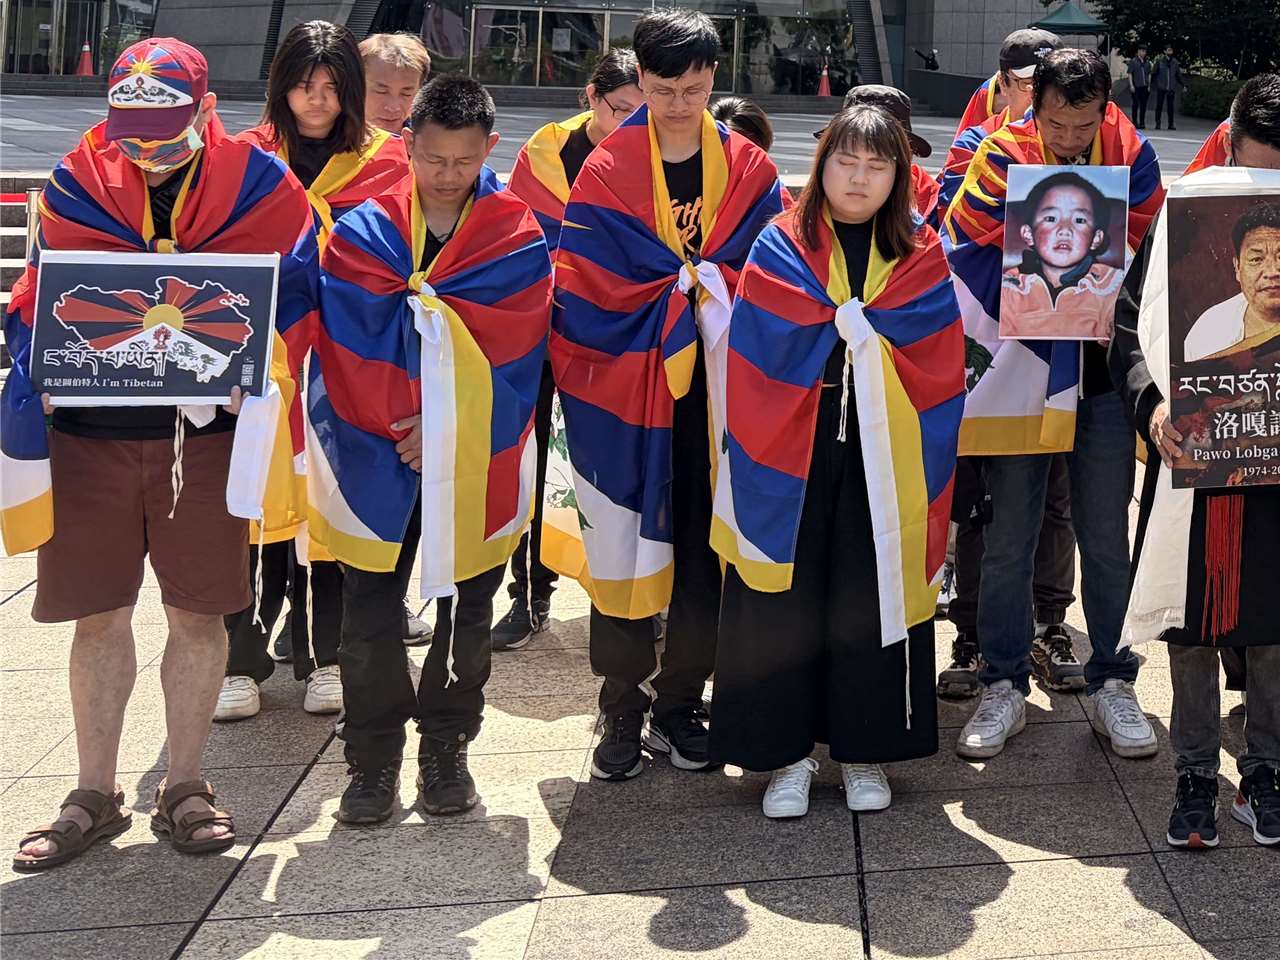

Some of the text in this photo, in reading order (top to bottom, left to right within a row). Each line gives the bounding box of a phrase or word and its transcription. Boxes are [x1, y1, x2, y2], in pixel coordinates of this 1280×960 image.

[102, 378, 120, 387] I'm
[123, 378, 164, 387] Tibetan
[1193, 448, 1231, 461] Pawo
[1236, 445, 1278, 461] Lobga
